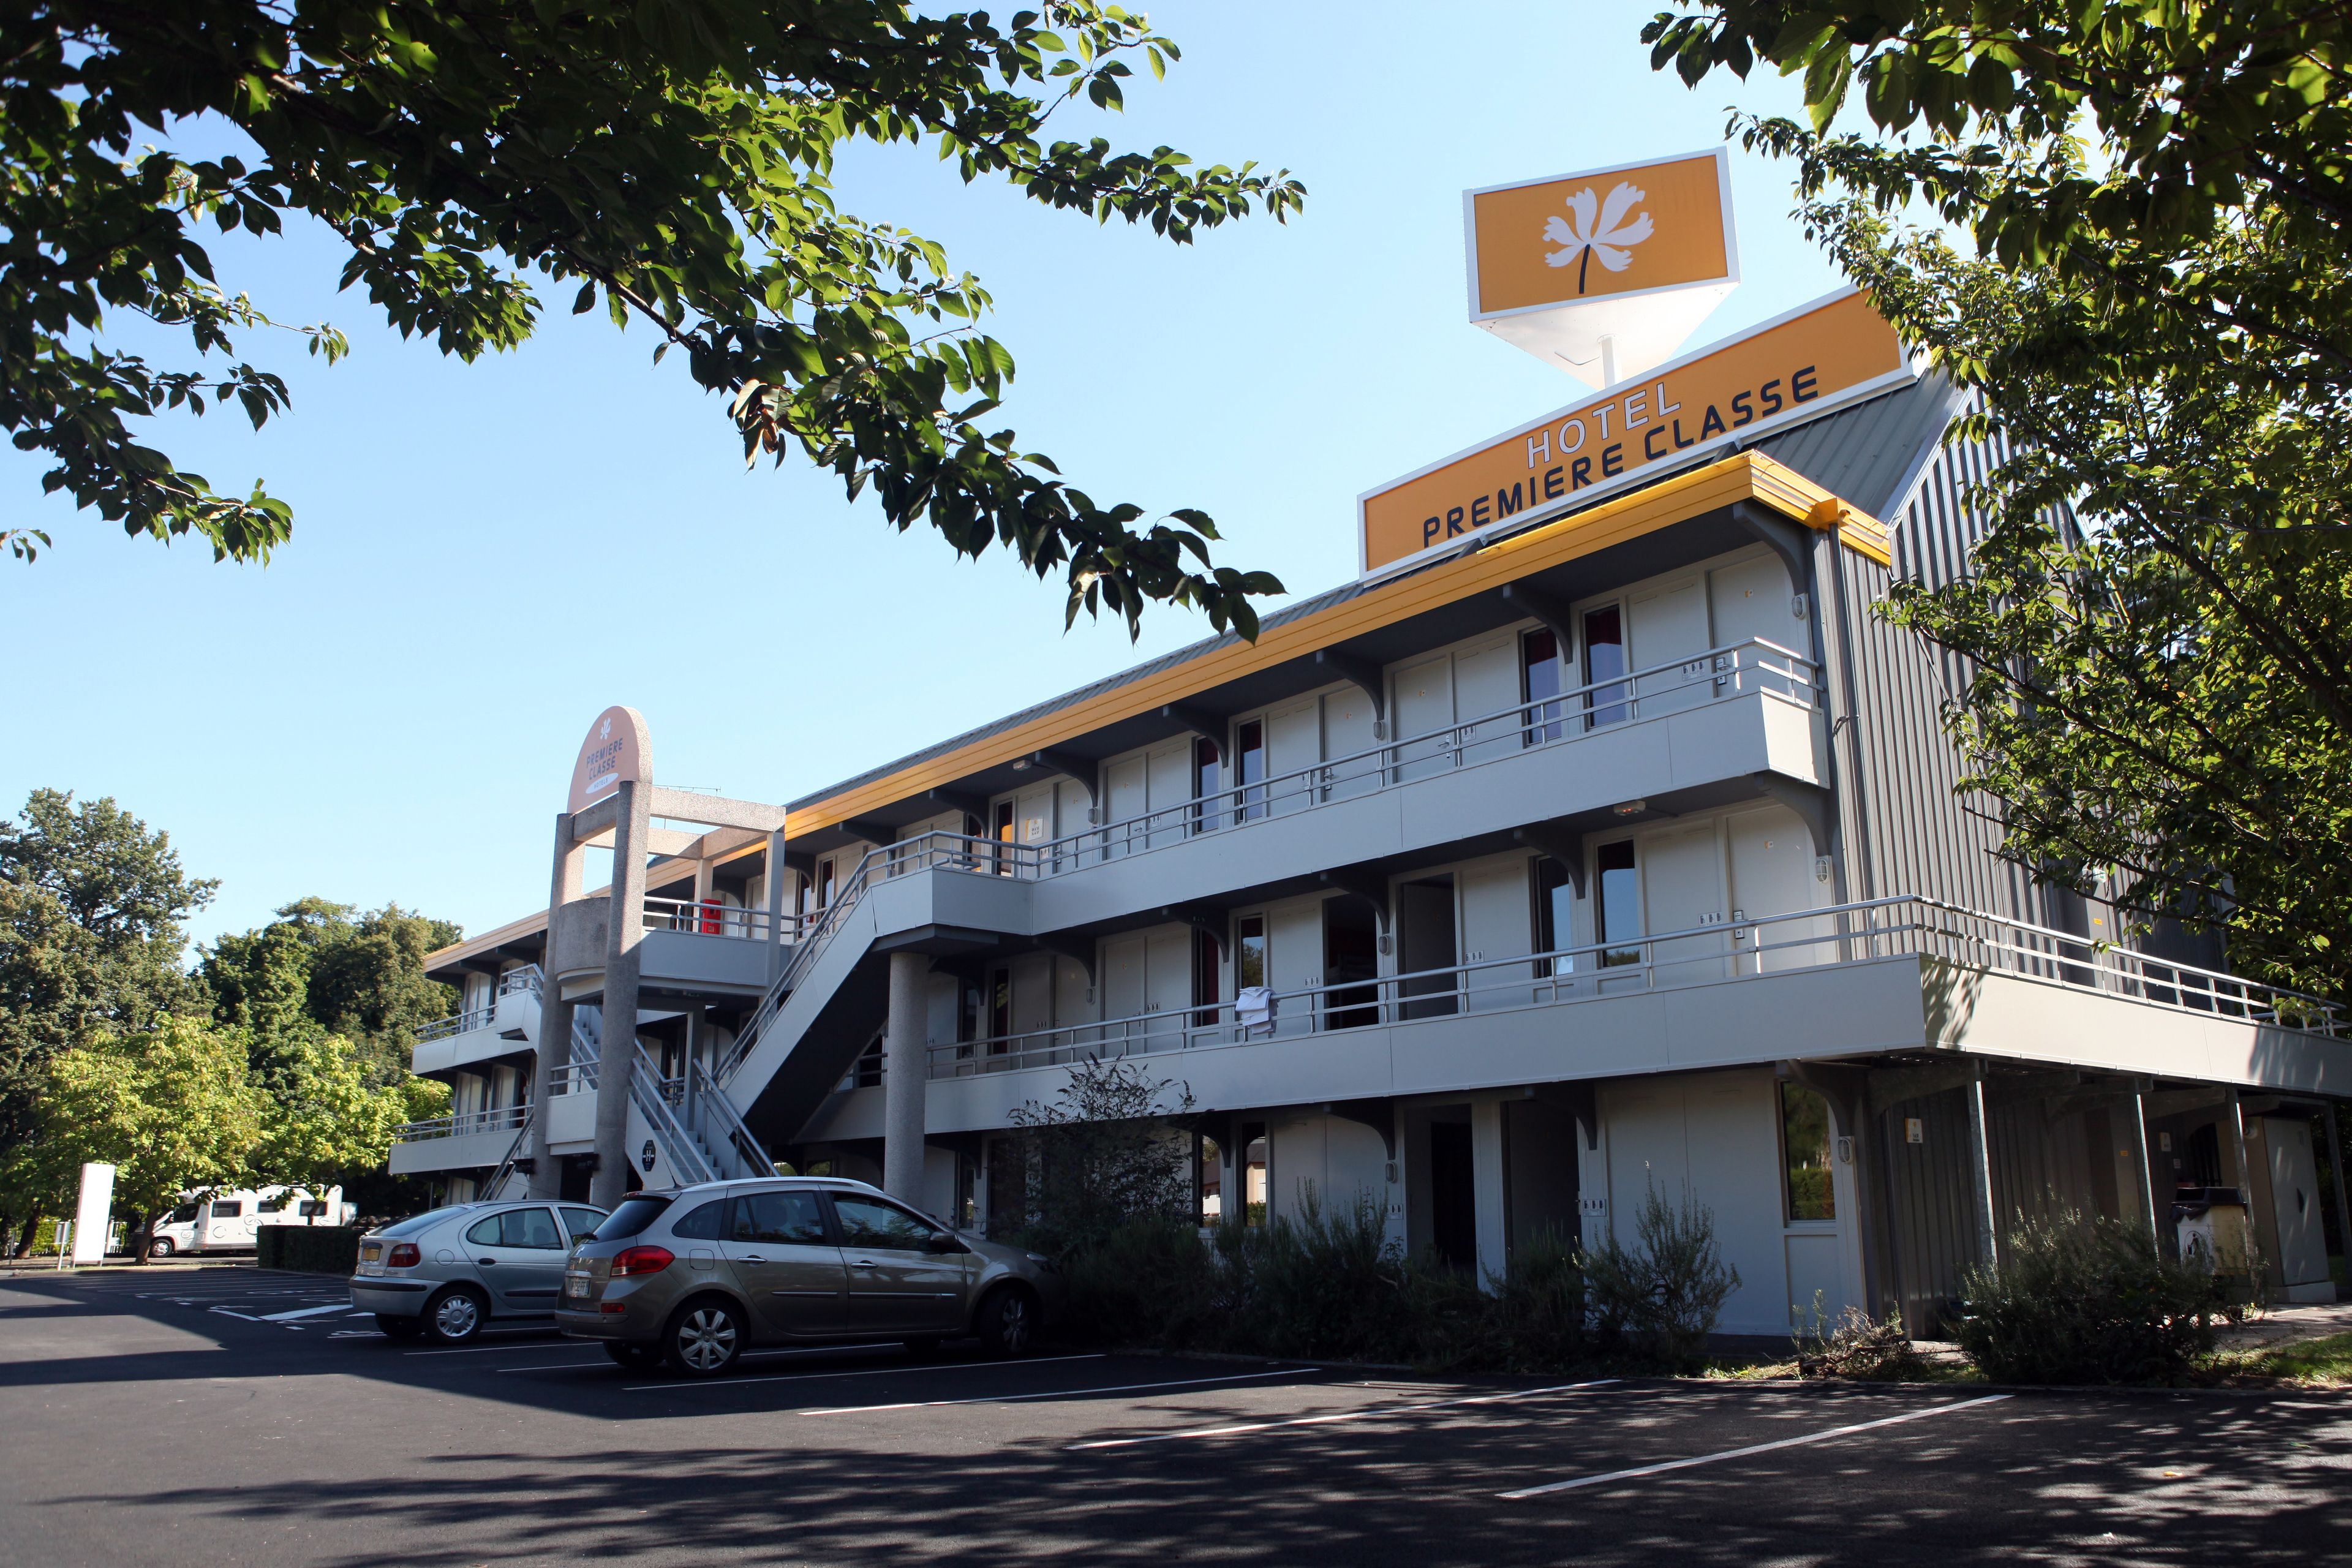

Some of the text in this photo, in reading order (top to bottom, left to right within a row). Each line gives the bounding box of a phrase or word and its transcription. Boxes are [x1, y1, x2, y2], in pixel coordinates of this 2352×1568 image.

[1527, 382, 1681, 470] HOTEL
[1423, 365, 1820, 548] PREMIERE CLASSE
[587, 738, 623, 768] PREMIERE
[589, 755, 616, 780] CLASSE
[594, 777, 608, 788] HOTELS
